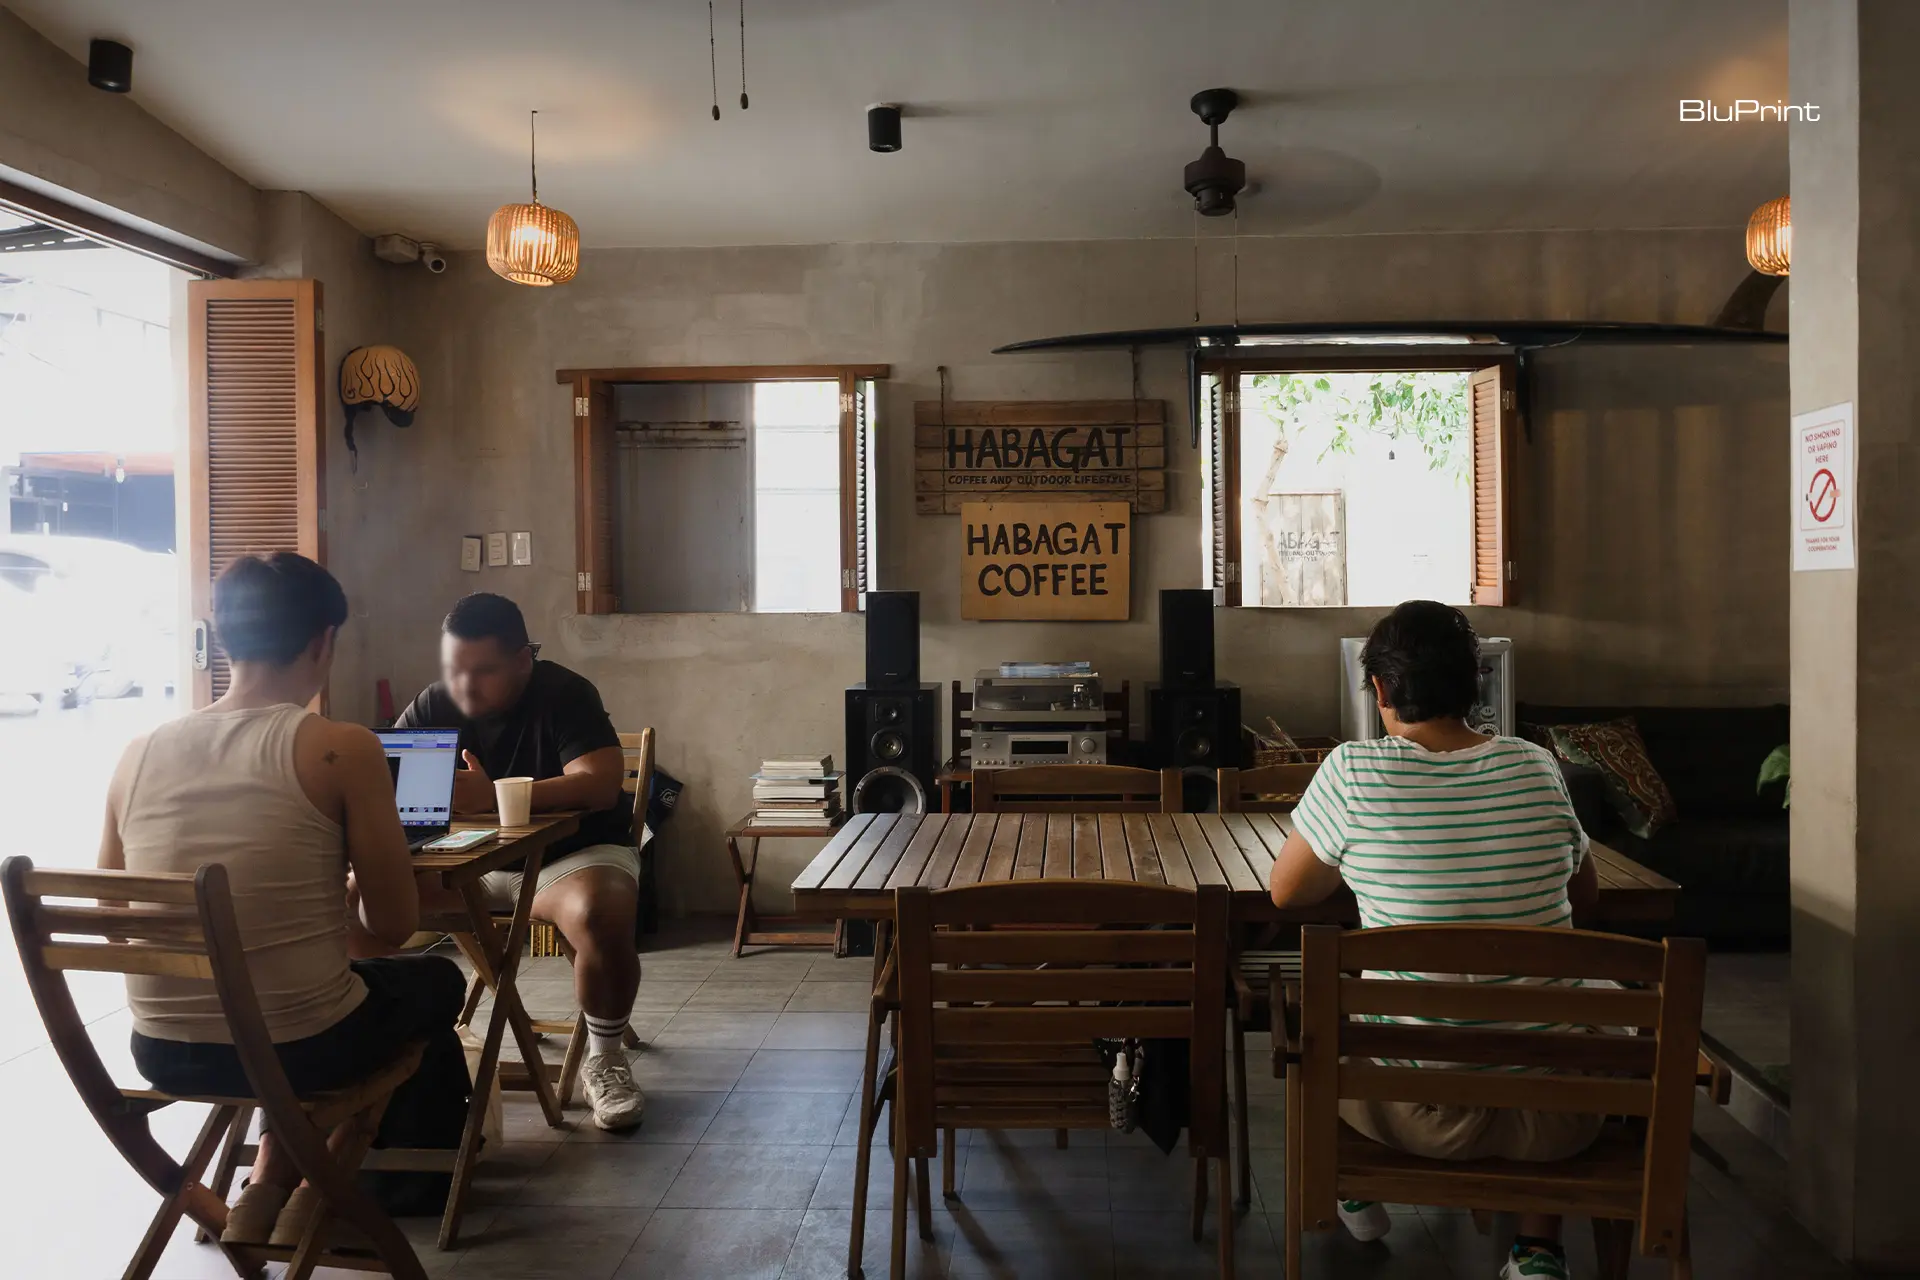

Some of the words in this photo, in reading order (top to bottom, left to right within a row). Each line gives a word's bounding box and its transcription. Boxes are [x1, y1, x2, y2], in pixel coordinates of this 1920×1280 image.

[1804, 434, 1814, 442] NO
[1814, 428, 1840, 440] SMOKING
[947, 427, 1131, 473] HABAGAT
[1807, 445, 1816, 454] OR
[1816, 440, 1838, 452] VAPING
[1815, 454, 1829, 464] HERE
[948, 475, 988, 485] COFFEE
[989, 475, 1012, 485] AND
[1017, 475, 1072, 485] OUTDOOR
[1074, 475, 1131, 485] LIFESTYLE
[967, 522, 1126, 556] HABAGAT
[978, 563, 1108, 597] COFFEE
